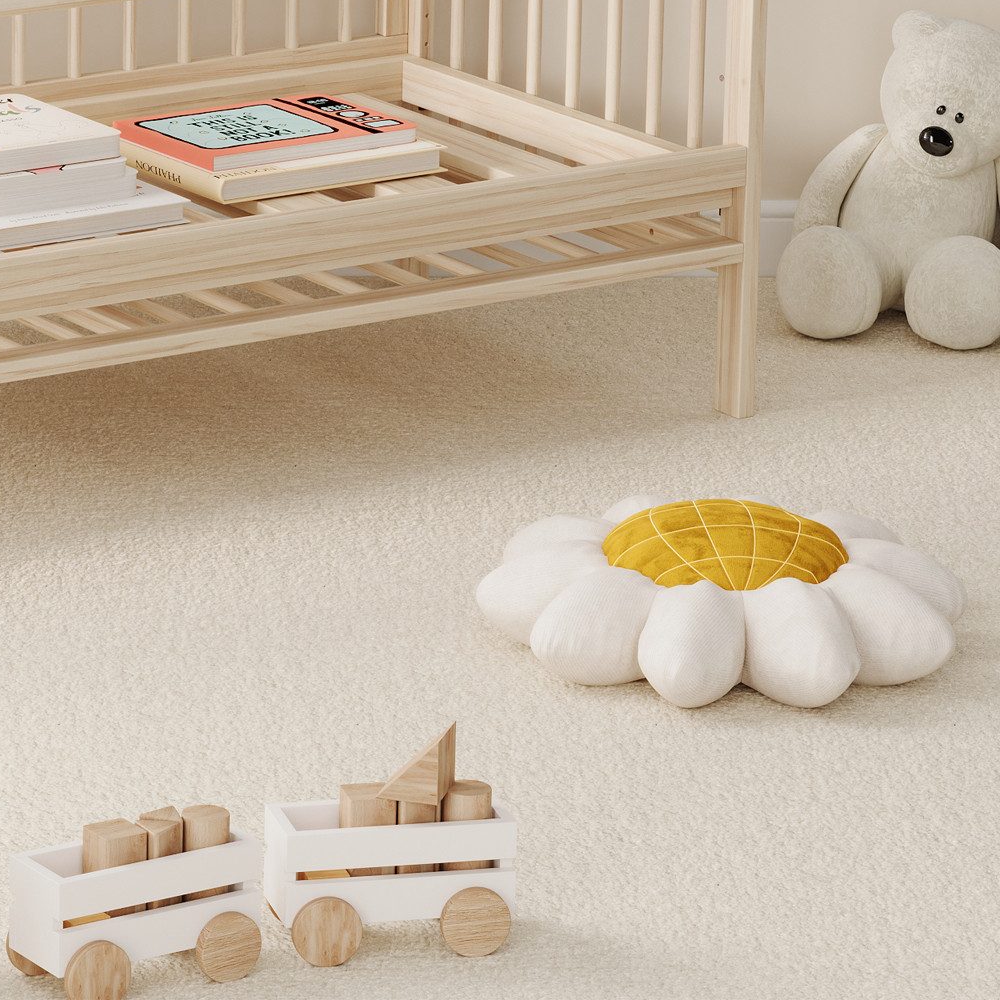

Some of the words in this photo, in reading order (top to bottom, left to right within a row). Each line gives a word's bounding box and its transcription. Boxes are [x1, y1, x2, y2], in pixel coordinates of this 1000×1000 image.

[187, 118, 235, 128] THIS
[210, 121, 261, 132] STILL
[219, 127, 258, 137] NOT
[230, 128, 296, 142] BOOK!
[135, 158, 182, 185] PHAIDON
